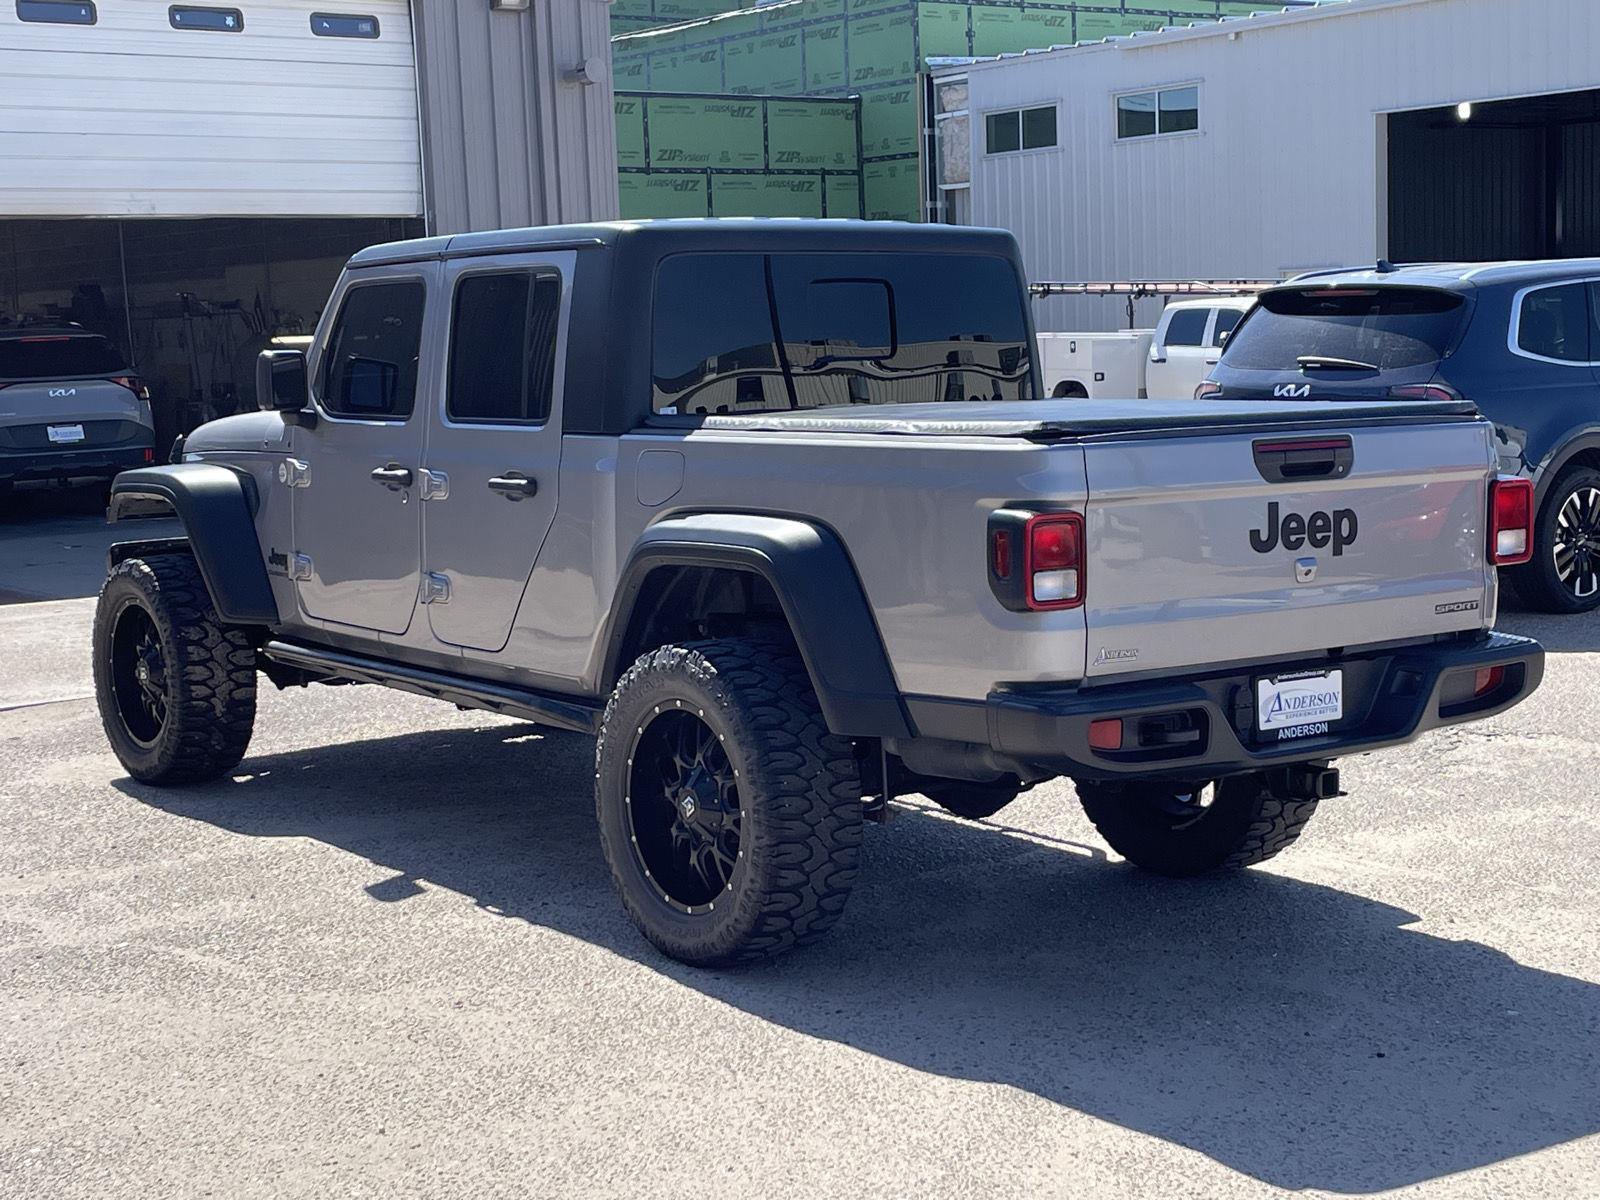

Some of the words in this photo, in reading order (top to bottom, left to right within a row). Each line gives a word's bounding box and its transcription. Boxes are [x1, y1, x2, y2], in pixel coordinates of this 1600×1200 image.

[730, 106, 757, 118] ZIP
[656, 149, 683, 162] ZIP
[775, 151, 801, 163] ZIP
[673, 179, 700, 192] ZIP
[791, 181, 816, 192] ZIP
[49, 388, 76, 397] KIA
[1273, 384, 1310, 397] KIA
[1249, 501, 1358, 556] Jeep
[1435, 602, 1479, 614] SPORT
[1264, 691, 1339, 723] ANDERSON
[1278, 722, 1328, 739] ANDERSON
